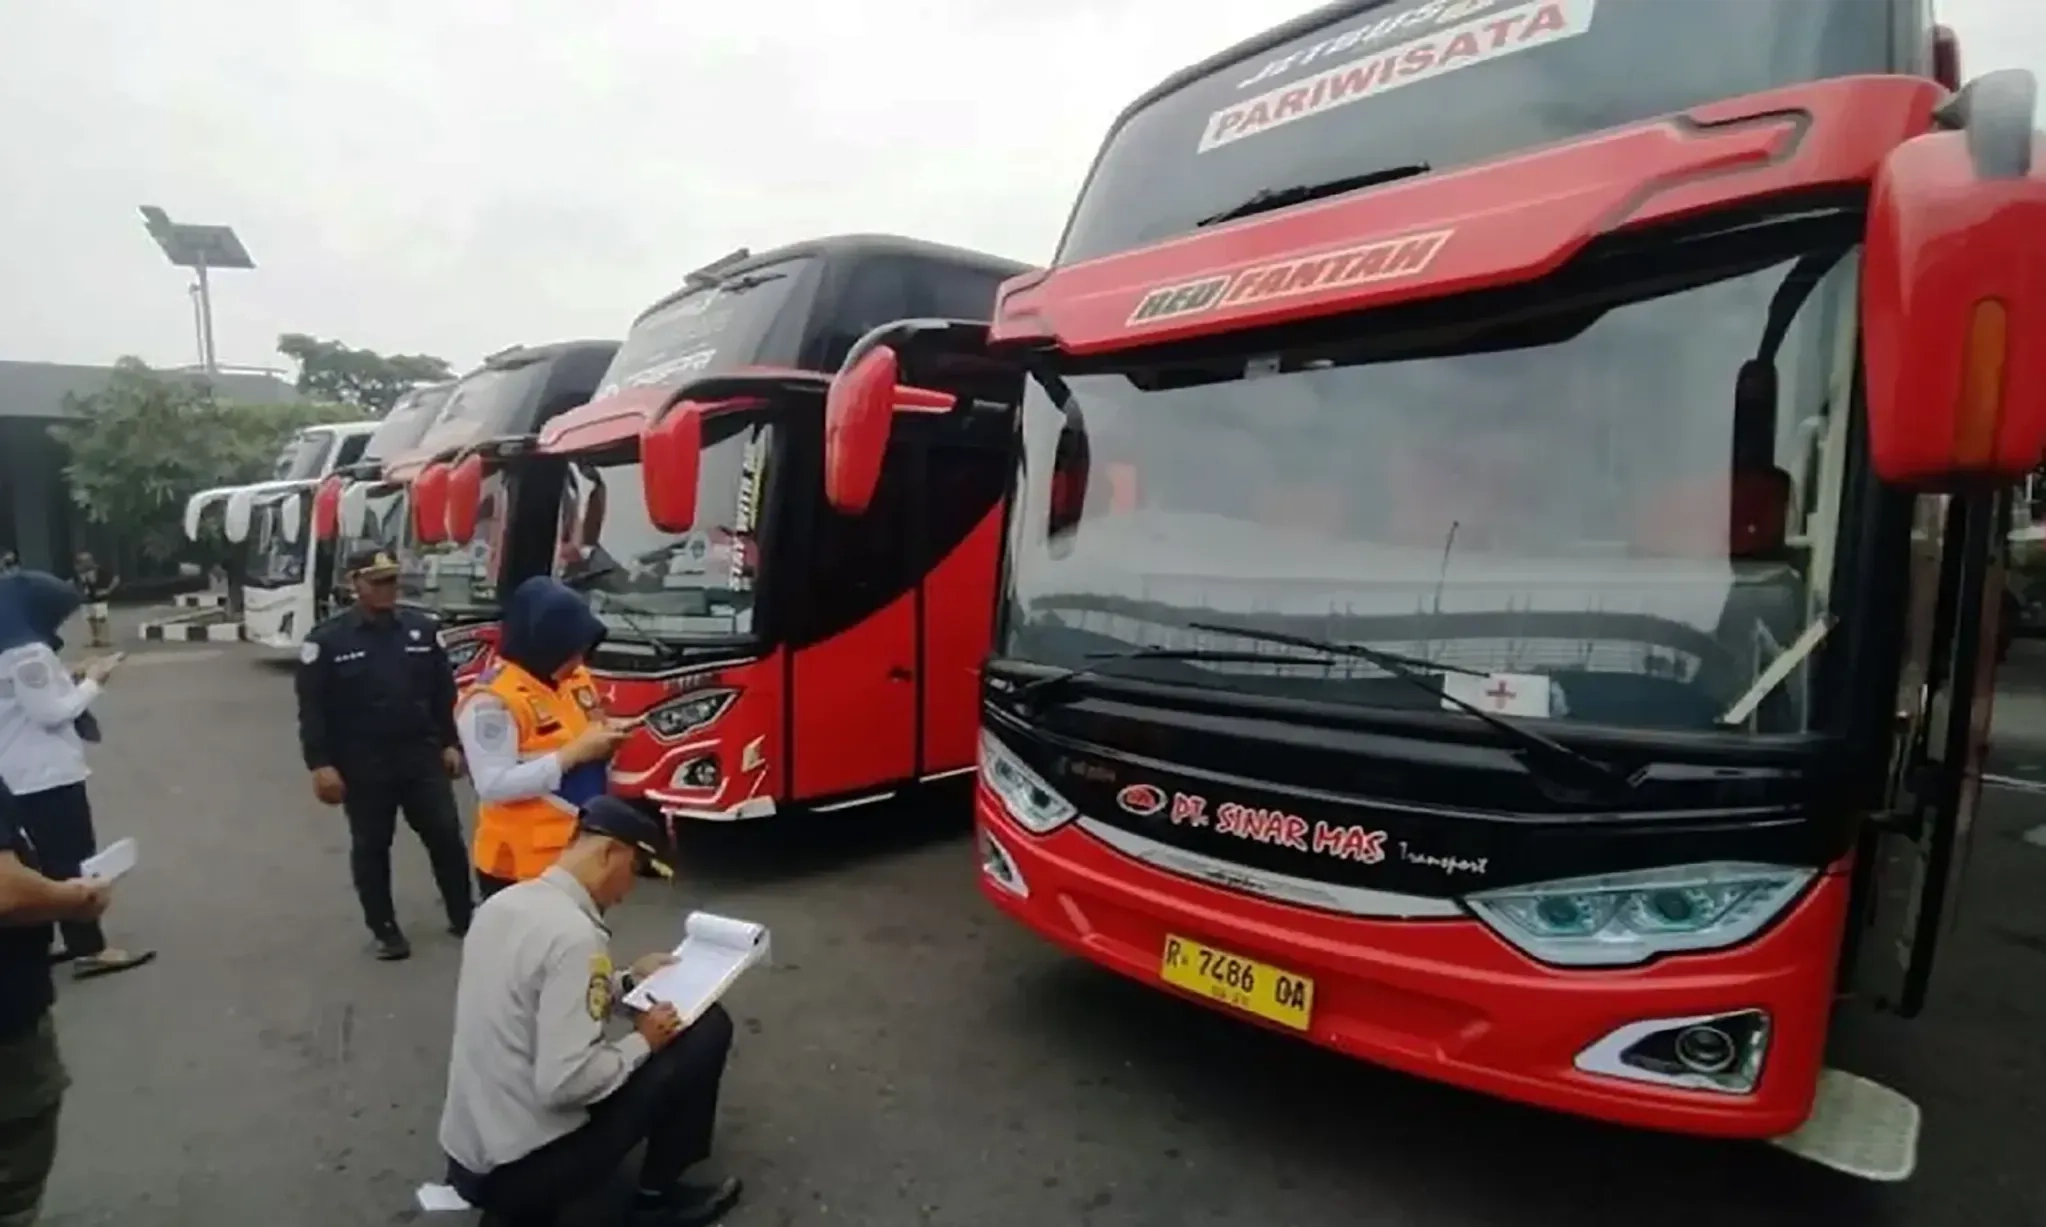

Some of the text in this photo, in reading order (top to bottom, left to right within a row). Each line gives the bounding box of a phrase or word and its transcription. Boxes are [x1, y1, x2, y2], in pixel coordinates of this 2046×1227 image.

[1214, 3, 1568, 140] PARIWISATA
[1215, 802, 1309, 852] SINAR
[1312, 820, 1388, 864] MAS
[1398, 841, 1488, 874] Transport
[1199, 949, 1254, 993] 7486
